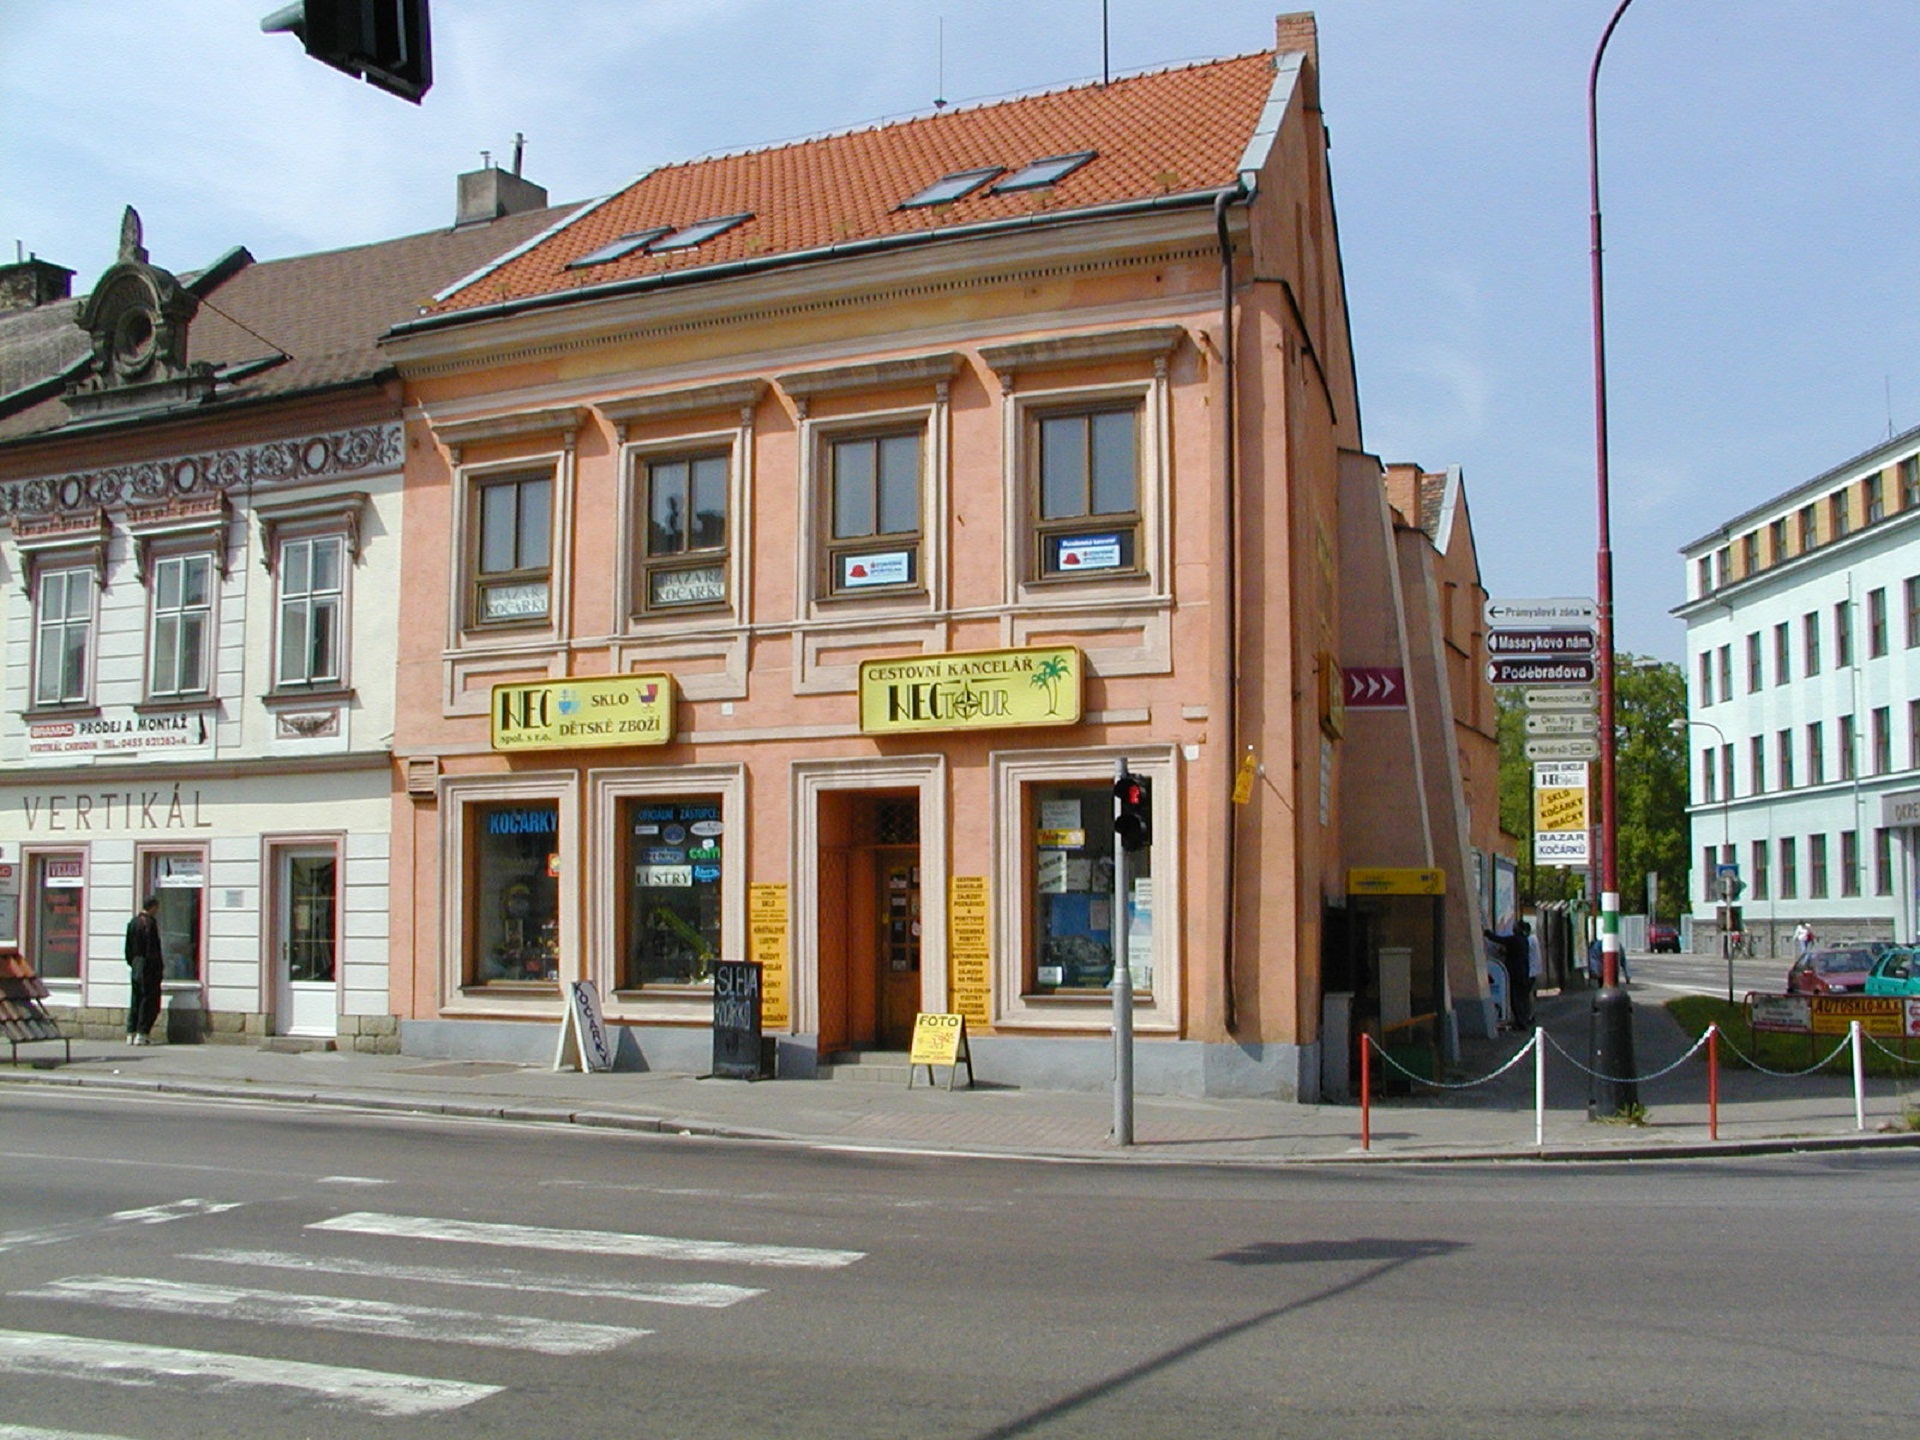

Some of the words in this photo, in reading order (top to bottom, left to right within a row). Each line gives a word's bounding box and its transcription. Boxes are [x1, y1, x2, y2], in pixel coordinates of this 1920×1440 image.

[1499, 635, 1563, 652] Masarykovo
[1566, 636, 1592, 649] nám.
[869, 661, 941, 681] CESTOVNÍ
[947, 656, 1033, 676] KANCELÁŘ
[1501, 665, 1586, 680] Poděbradova
[501, 689, 552, 731] NEC
[592, 692, 629, 708] SKLO
[79, 720, 120, 734] PRODEJ
[124, 720, 133, 732] A
[137, 713, 188, 733] MONTÁŽ
[559, 719, 614, 736] DĚTSKÉ
[618, 715, 661, 733] ZBOŽÍ
[24, 782, 212, 830] VERTIKÁL
[1546, 789, 1571, 804] SKLO
[1540, 833, 1585, 841] BAZAR
[636, 871, 691, 885] LUSTRY
[716, 965, 758, 998] SLEVA
[919, 1015, 959, 1027] FOTO
